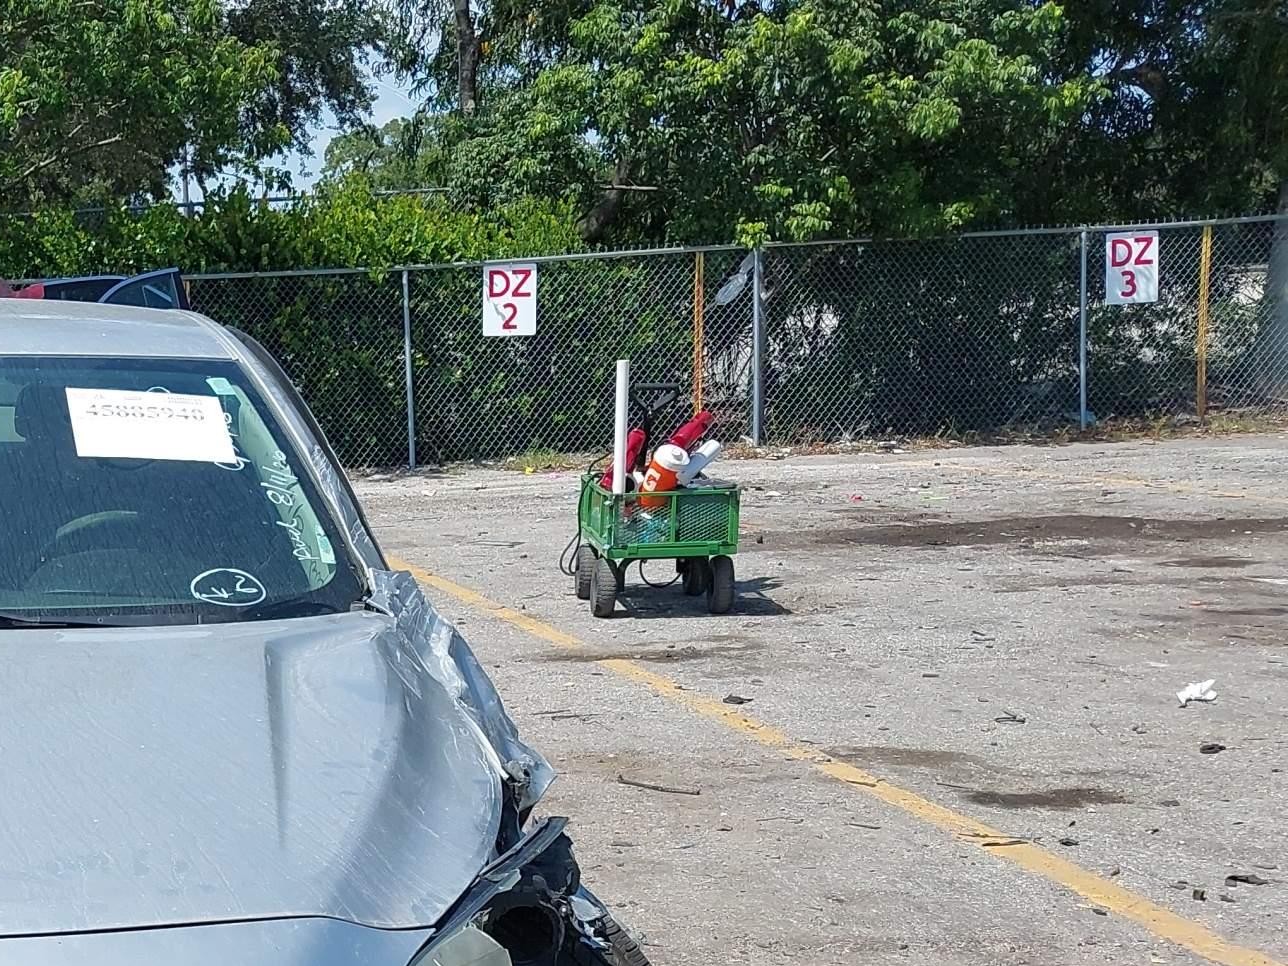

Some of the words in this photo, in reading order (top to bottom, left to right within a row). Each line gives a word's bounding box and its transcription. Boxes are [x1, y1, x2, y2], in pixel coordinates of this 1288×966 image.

[1111, 236, 1154, 268] DZ
[488, 269, 532, 298] DZ
[1120, 270, 1137, 298] 3
[502, 302, 518, 330] 2
[642, 468, 662, 492] G
